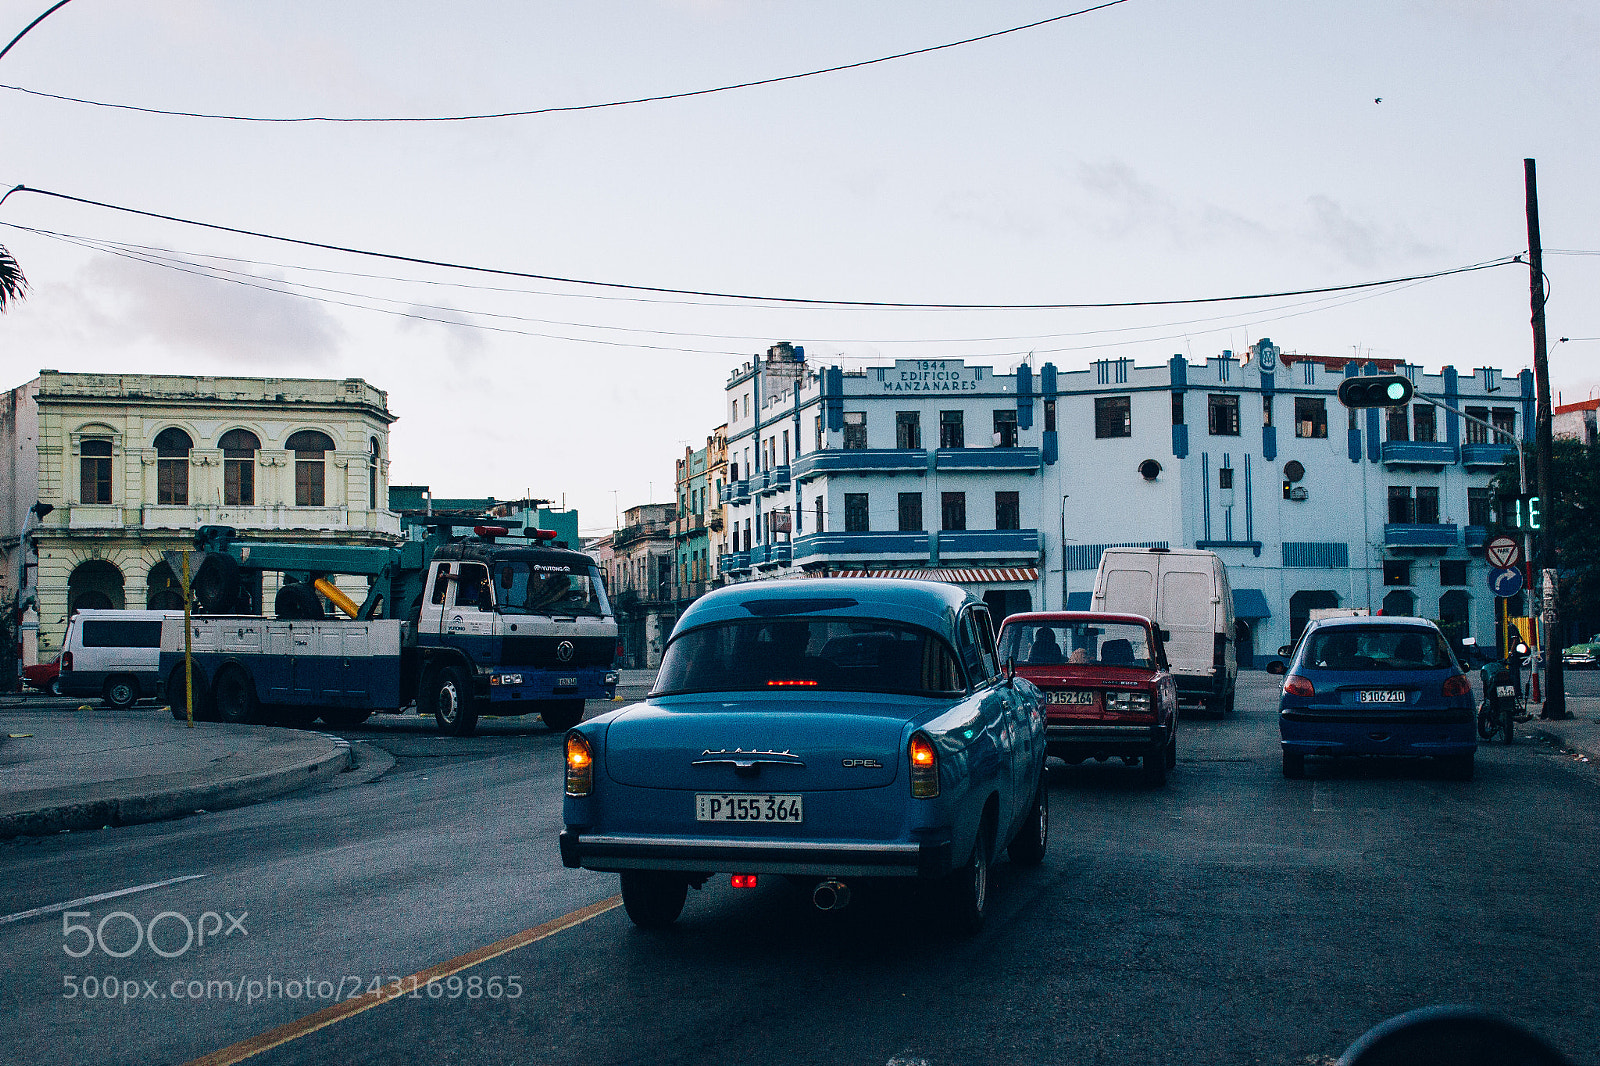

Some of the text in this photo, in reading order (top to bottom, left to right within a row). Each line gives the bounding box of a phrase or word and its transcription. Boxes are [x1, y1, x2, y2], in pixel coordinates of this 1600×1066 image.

[917, 361, 945, 370] 1944
[900, 371, 960, 381] EDIFICIO
[883, 380, 977, 391] MANZANARES
[1360, 692, 1366, 701] B
[842, 759, 882, 768] OPEL
[710, 799, 800, 821] P 155 364
